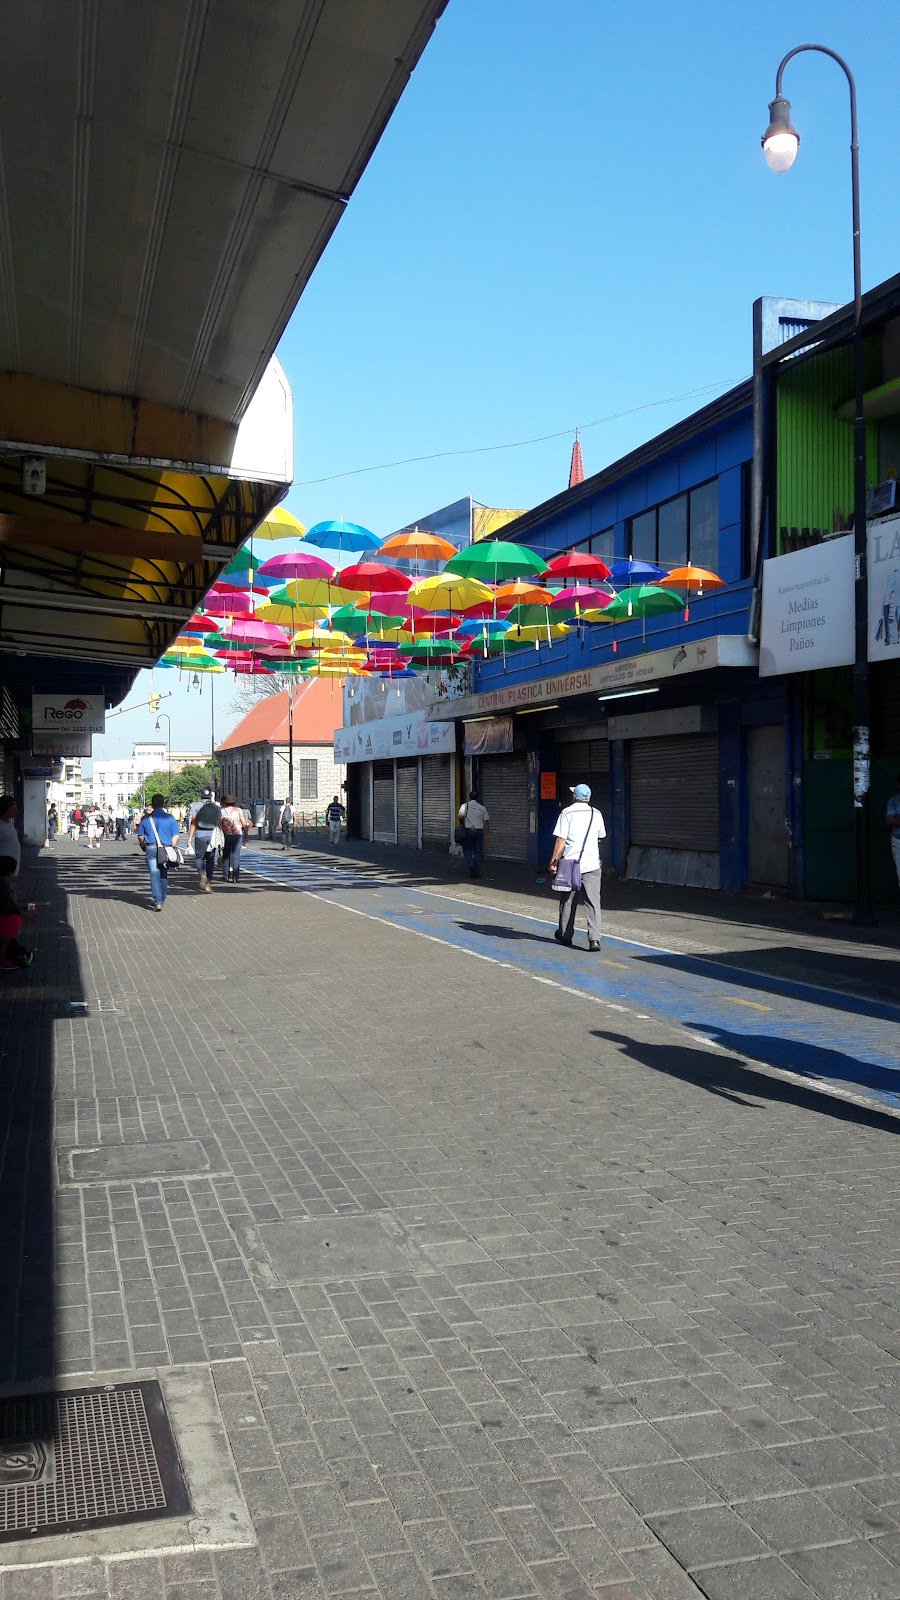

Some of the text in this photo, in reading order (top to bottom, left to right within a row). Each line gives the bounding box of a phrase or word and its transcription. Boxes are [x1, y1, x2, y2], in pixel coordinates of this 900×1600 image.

[788, 597, 819, 615] Medias
[781, 615, 826, 635] Limpiones
[789, 637, 815, 652] Paños
[627, 670, 634, 678] DE
[635, 667, 654, 676] HOGAR
[478, 693, 505, 708] CENTRAL
[508, 683, 543, 702] PLASTICA
[546, 674, 592, 695] UNIVERSAL
